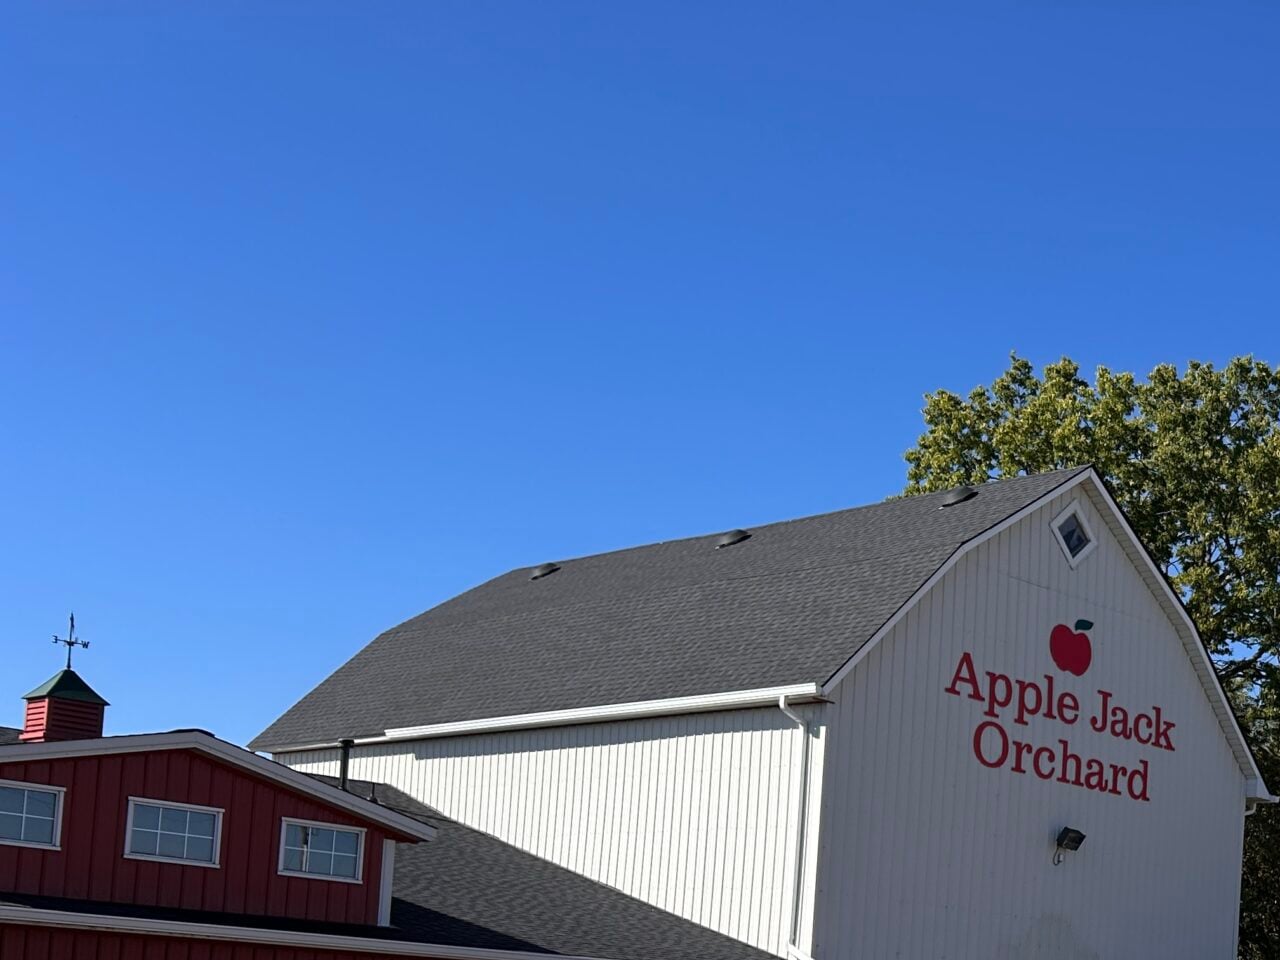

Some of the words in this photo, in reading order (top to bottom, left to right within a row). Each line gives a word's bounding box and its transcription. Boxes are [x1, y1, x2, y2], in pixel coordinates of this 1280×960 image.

[944, 651, 1080, 726] Apple
[1090, 689, 1176, 751] Jack
[972, 720, 1151, 802] Orchard
